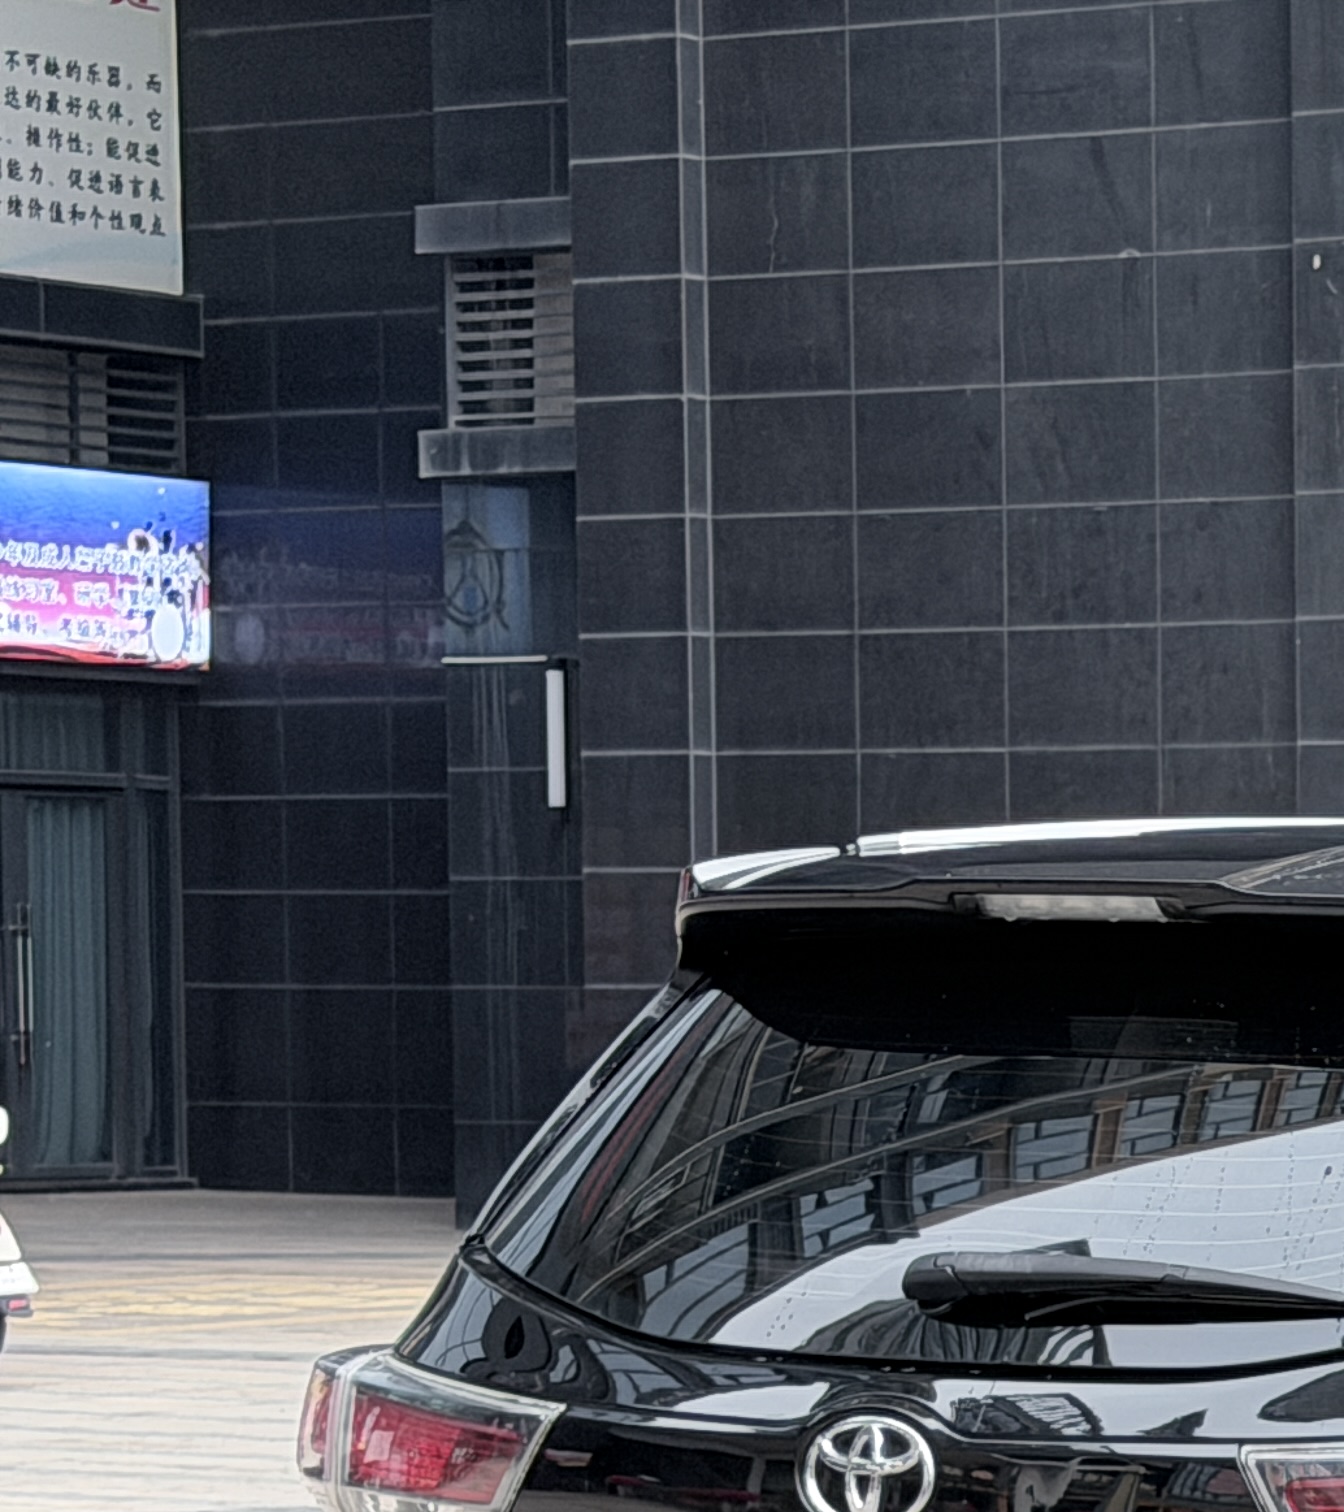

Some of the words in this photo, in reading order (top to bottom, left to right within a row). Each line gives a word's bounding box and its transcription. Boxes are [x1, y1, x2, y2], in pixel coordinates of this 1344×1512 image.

[0, 195, 166, 237] 绪价值和个性观点
